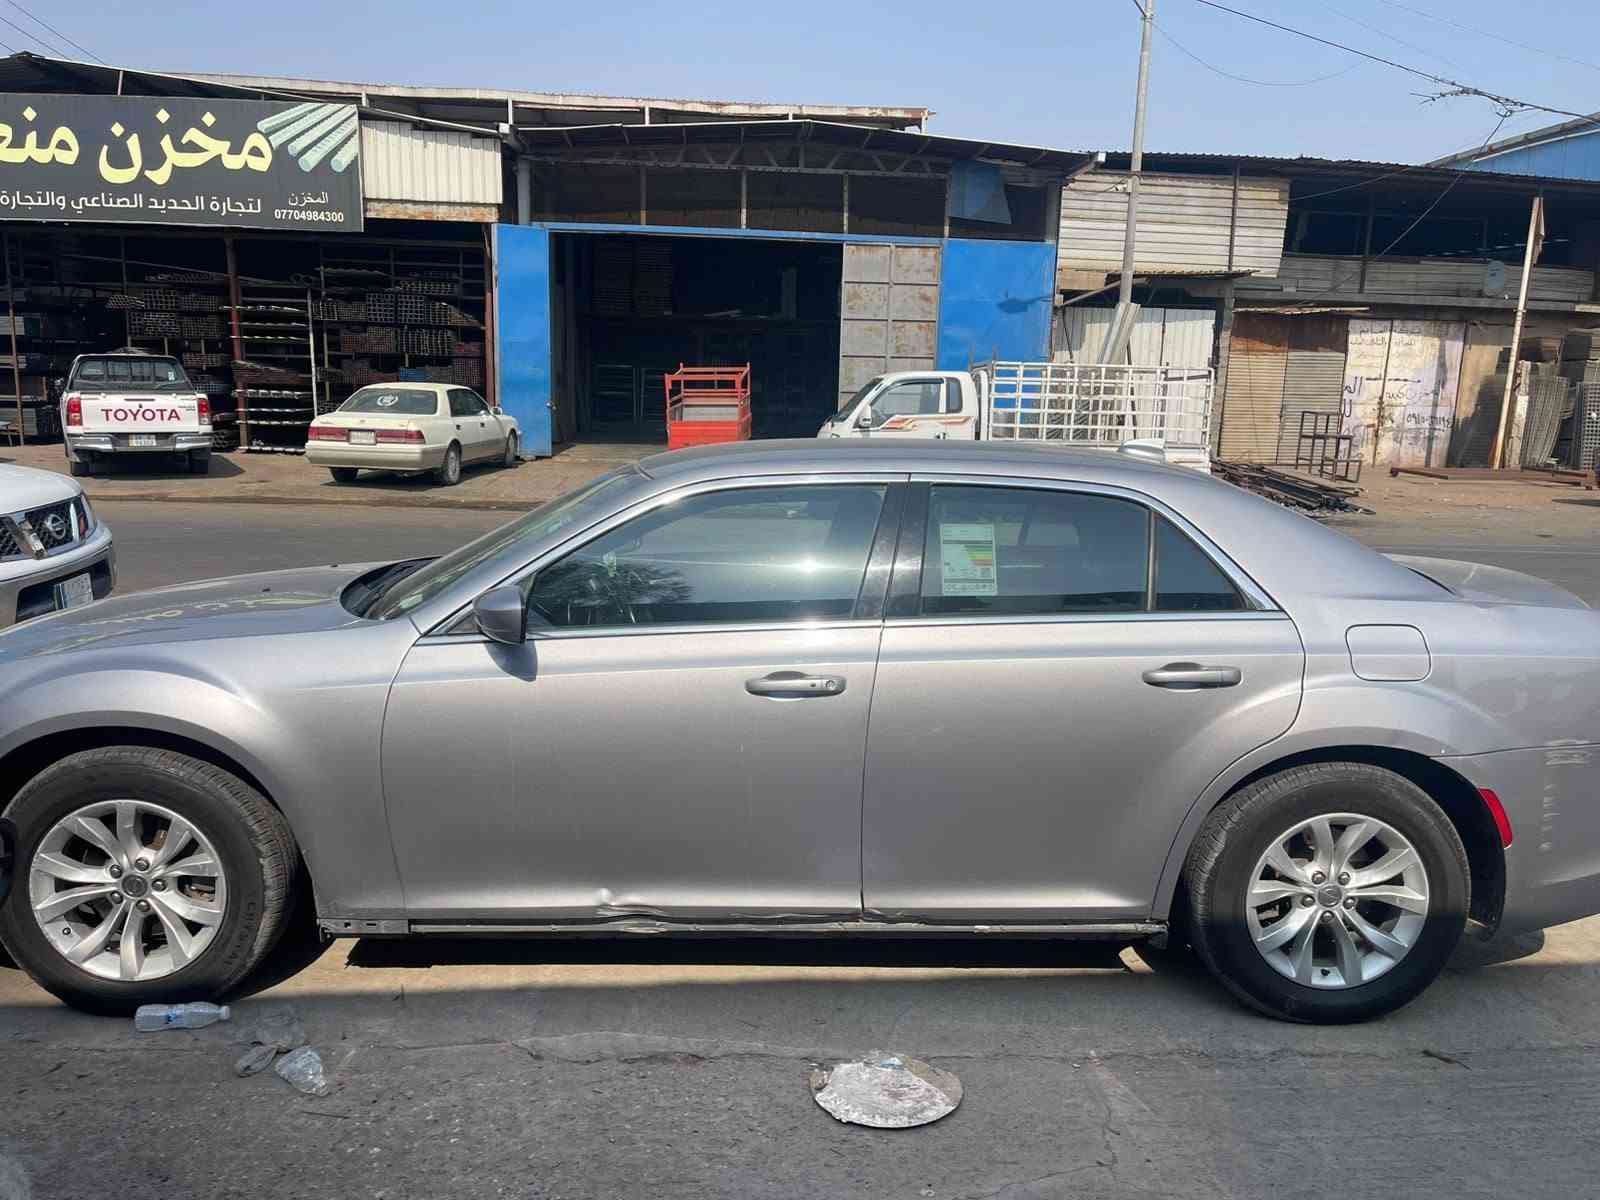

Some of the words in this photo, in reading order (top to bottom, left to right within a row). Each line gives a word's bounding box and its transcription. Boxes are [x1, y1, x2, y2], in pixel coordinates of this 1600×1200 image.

[98, 108, 273, 185] مخزن
[0, 190, 66, 210] والتجارة
[70, 192, 143, 214] الصناعي
[148, 195, 205, 213] الحديد
[209, 196, 261, 216] لتجارة
[287, 191, 329, 206] المخزن
[274, 208, 345, 222] 07704984300
[101, 408, 180, 421] TOYOTA
